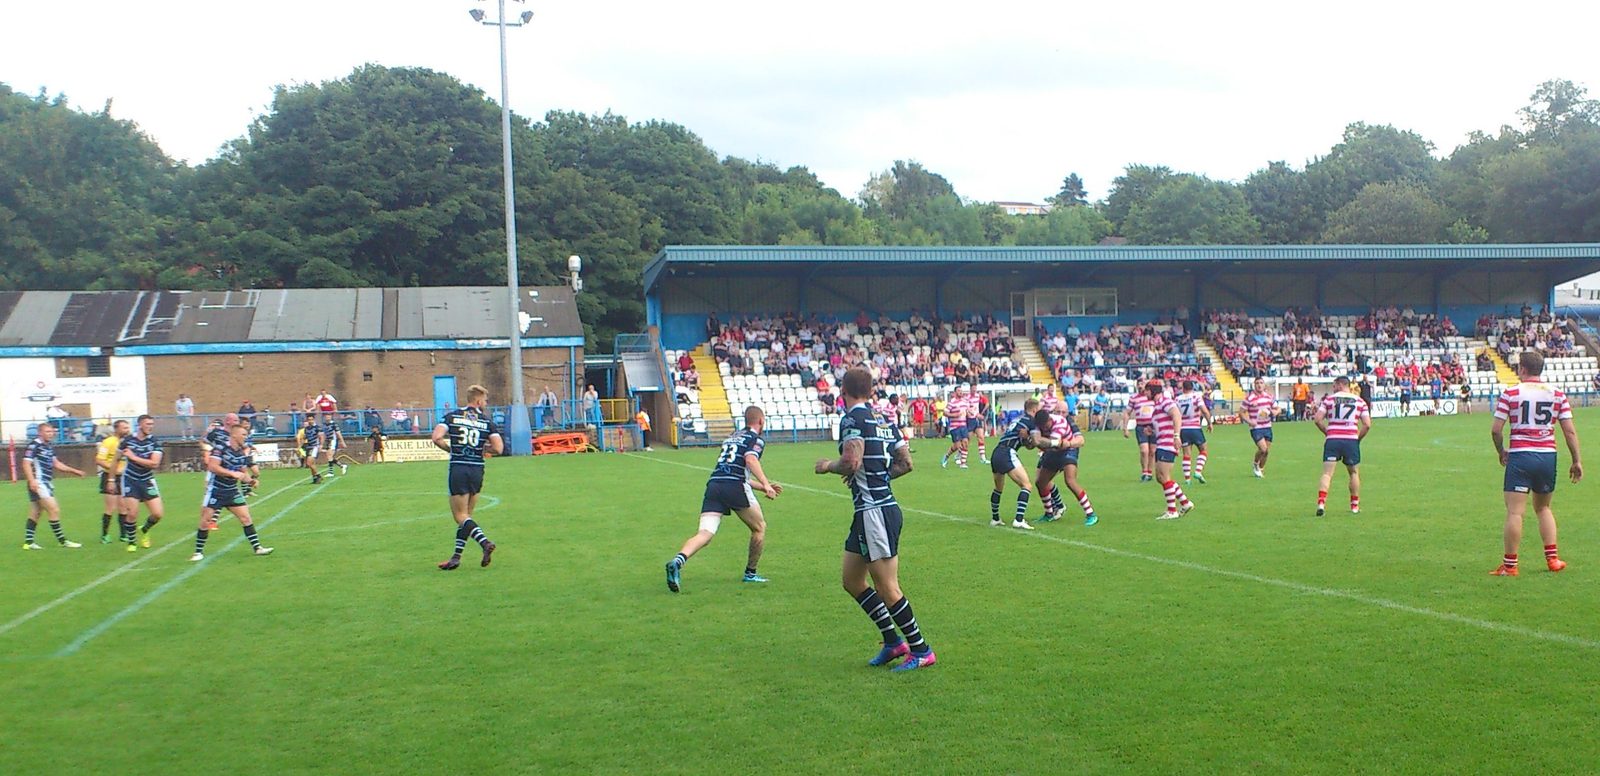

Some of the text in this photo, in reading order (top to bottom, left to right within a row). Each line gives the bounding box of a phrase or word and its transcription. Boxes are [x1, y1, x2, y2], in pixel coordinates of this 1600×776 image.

[1181, 403, 1190, 416] 7
[1334, 403, 1356, 420] 17
[1520, 400, 1553, 425] 15
[457, 426, 481, 447] 30
[717, 443, 738, 463] 23
